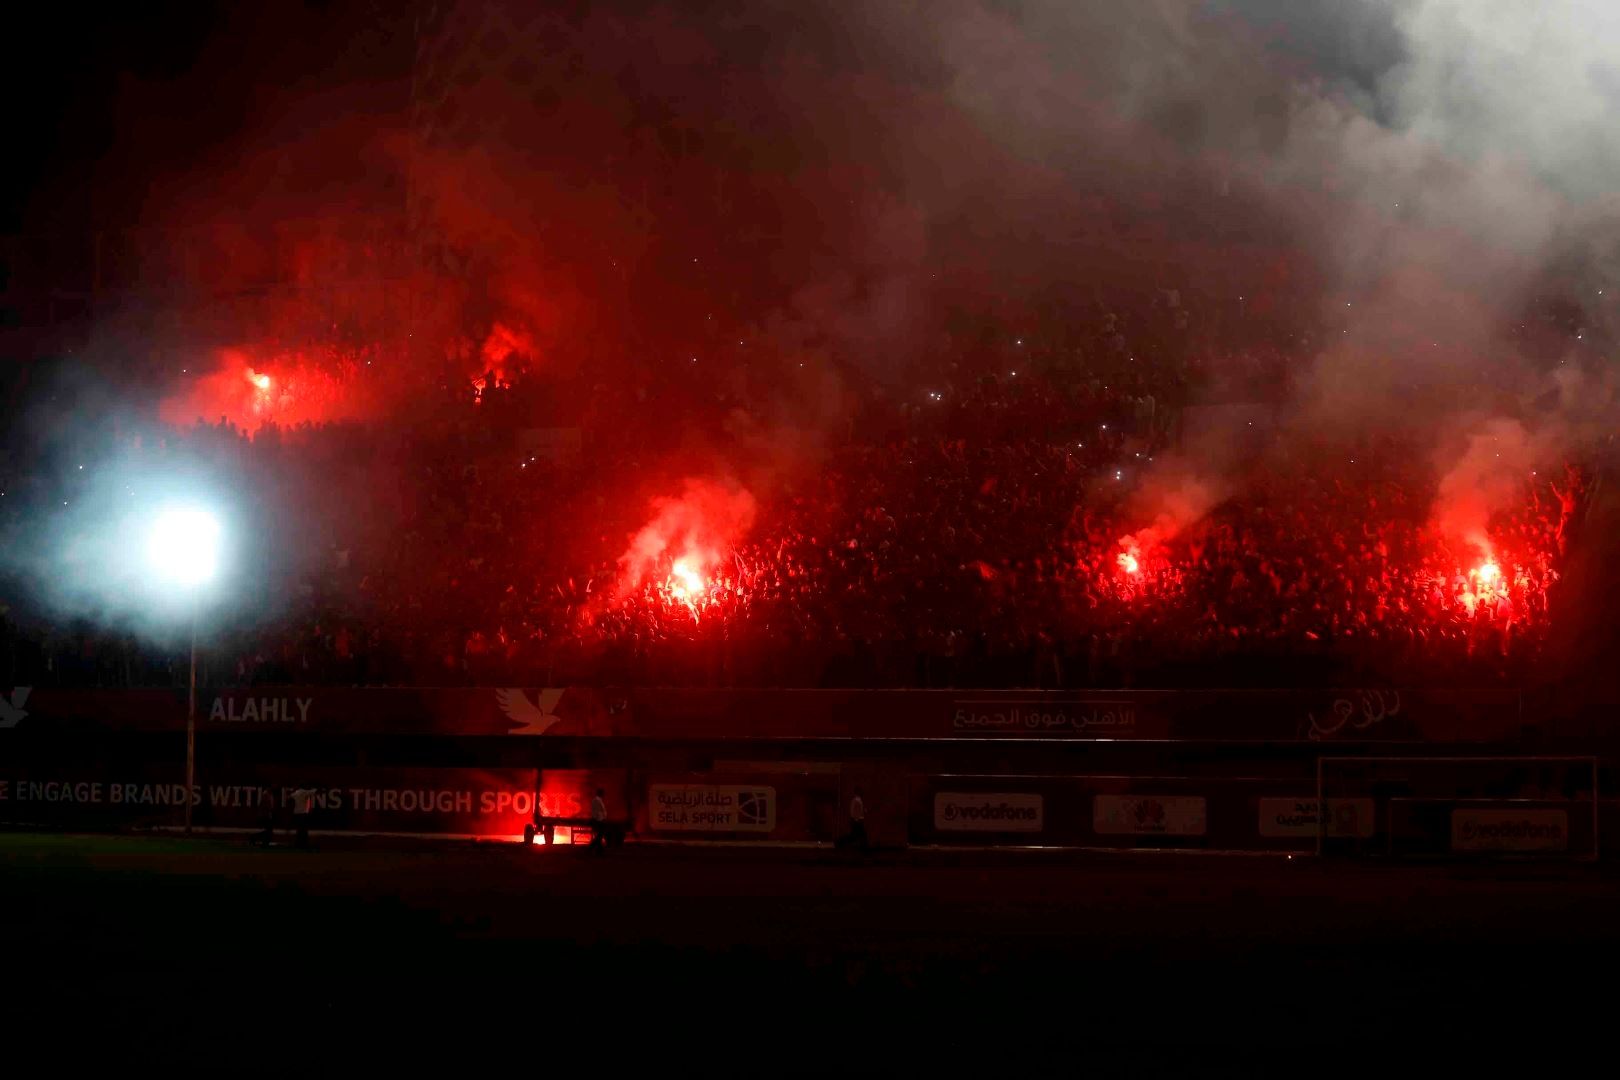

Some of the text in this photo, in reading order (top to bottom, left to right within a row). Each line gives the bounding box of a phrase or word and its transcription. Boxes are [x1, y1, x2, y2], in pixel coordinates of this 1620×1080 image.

[208, 696, 312, 723] ALAHLY
[952, 708, 1135, 733] الأهلي فوق الجميع
[16, 780, 103, 804] ENGAGE
[109, 783, 201, 806] BRANDS
[280, 787, 342, 810] FNS
[349, 789, 471, 813] THROUGH
[480, 791, 582, 816] SPORTS
[657, 811, 731, 825] SELA SPORT
[957, 803, 1037, 821] vodafone
